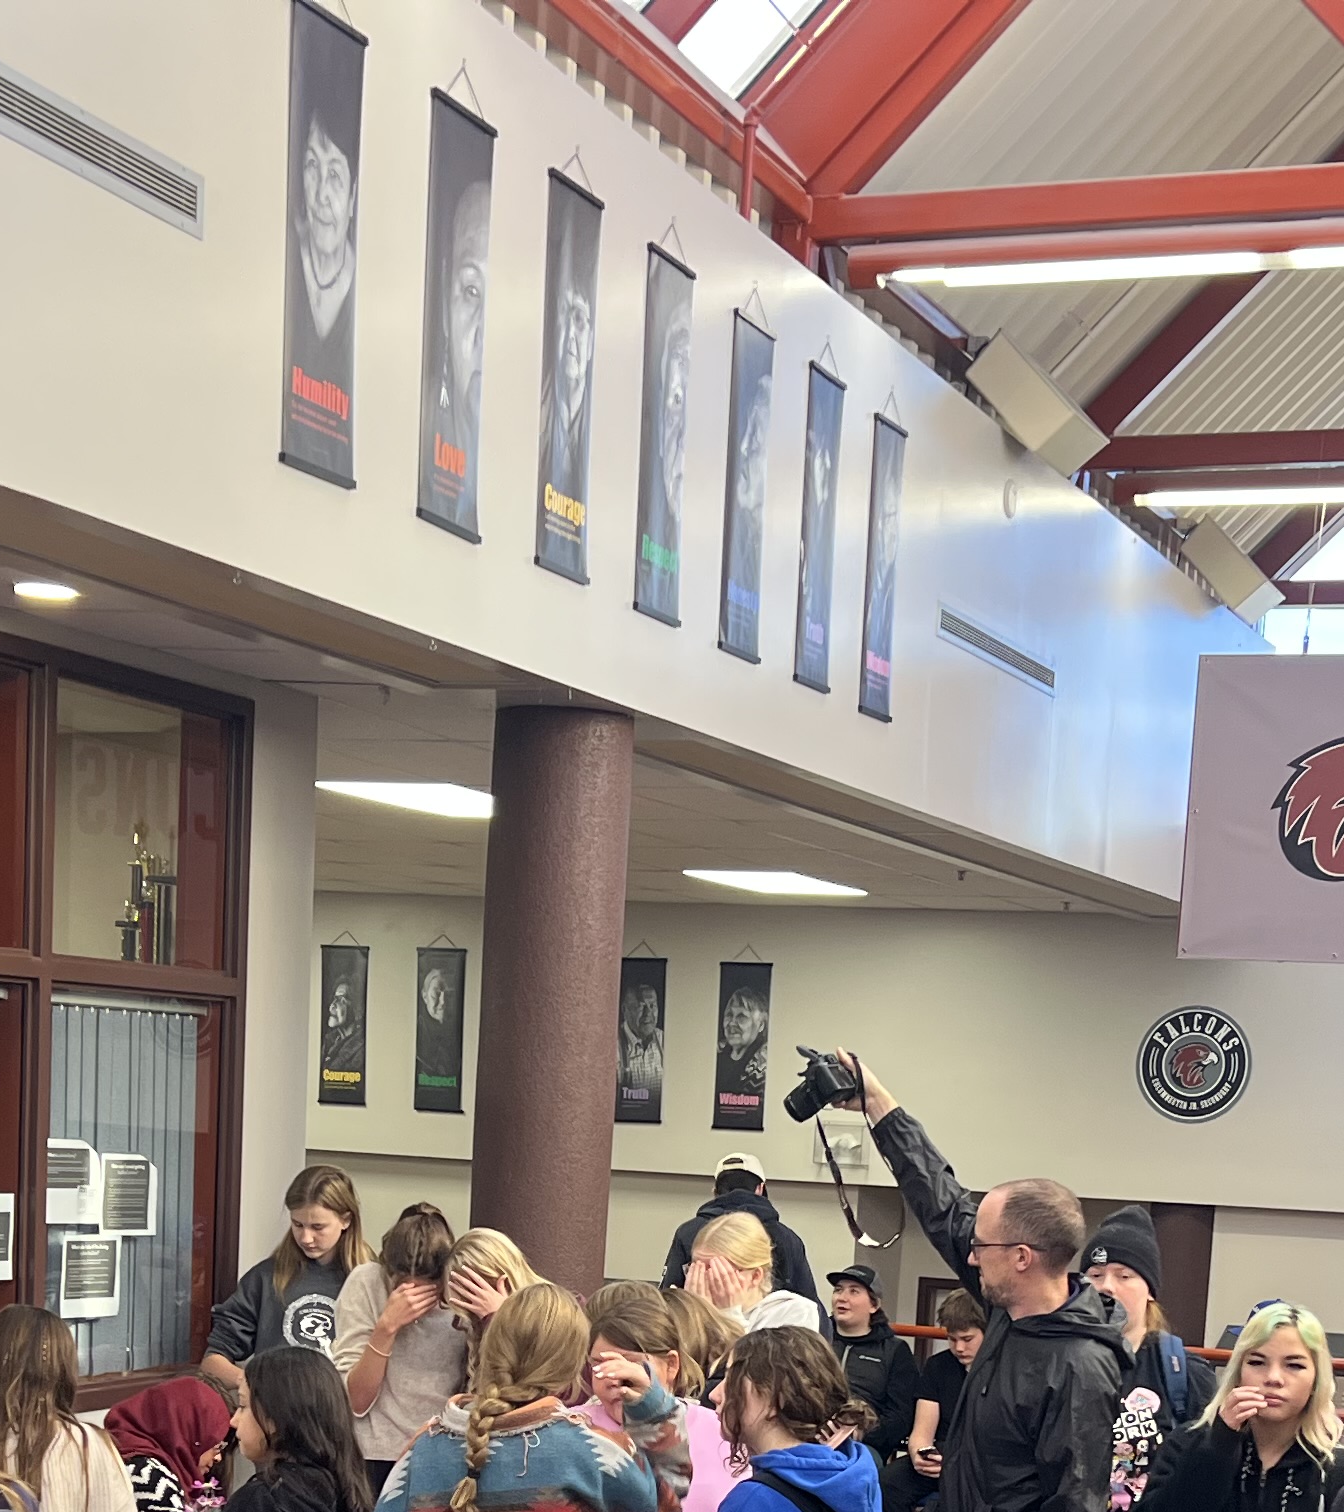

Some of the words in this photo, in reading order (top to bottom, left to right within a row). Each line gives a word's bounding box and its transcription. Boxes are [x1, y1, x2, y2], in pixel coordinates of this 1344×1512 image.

[291, 365, 350, 420] Humility
[434, 432, 465, 478] Love
[544, 482, 586, 527] Courage
[1153, 1013, 1240, 1051] FALCONS
[323, 1069, 361, 1083] Courage
[622, 1087, 649, 1100] Truth
[719, 1092, 760, 1106] Wisdom
